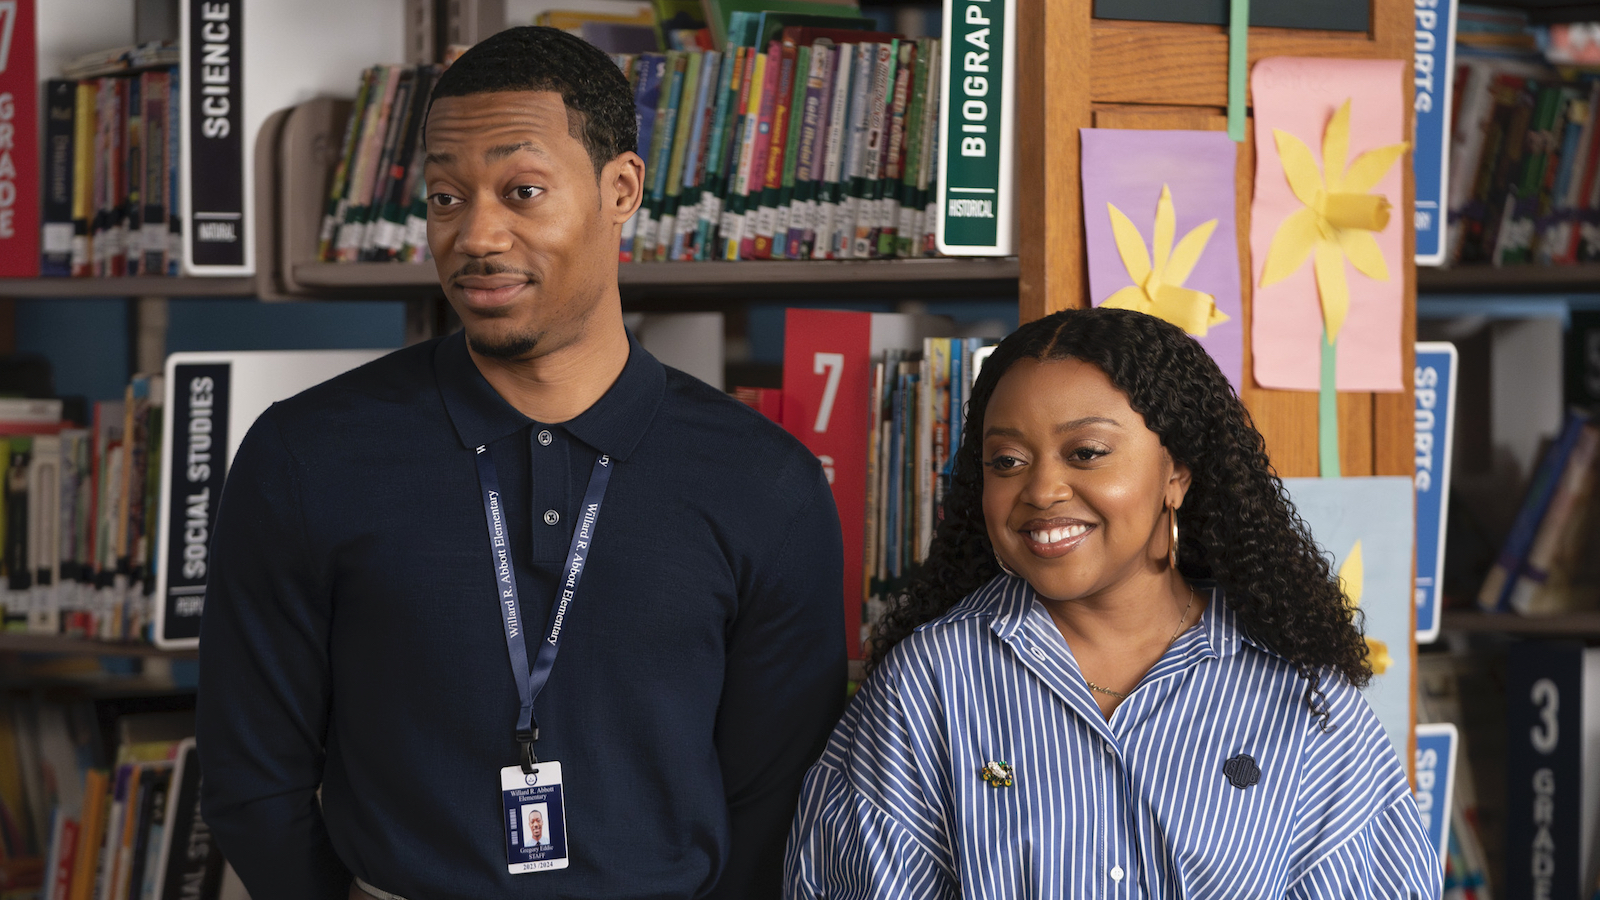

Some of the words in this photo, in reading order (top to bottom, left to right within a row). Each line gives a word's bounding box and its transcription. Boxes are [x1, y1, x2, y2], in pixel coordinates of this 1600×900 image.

[202, 2, 230, 139] SCIENCE
[961, 0, 990, 157] BIOGRAP
[948, 199, 994, 218] HISTORICAL
[813, 352, 844, 433] 7
[186, 376, 214, 482] STUDIES
[183, 487, 210, 579] SOCIAL
[488, 490, 505, 547] Elementary
[579, 503, 598, 539] Willard
[576, 541, 588, 551] R.
[498, 549, 511, 584] Abbott
[565, 553, 584, 588] Abbott
[503, 585, 514, 599] R.
[505, 600, 519, 639] Willard
[547, 588, 574, 646] Elementary
[1530, 677, 1560, 754] 3
[518, 794, 547, 802] Elementary
[537, 786, 554, 794] Abbott
[523, 863, 537, 871] 2023
